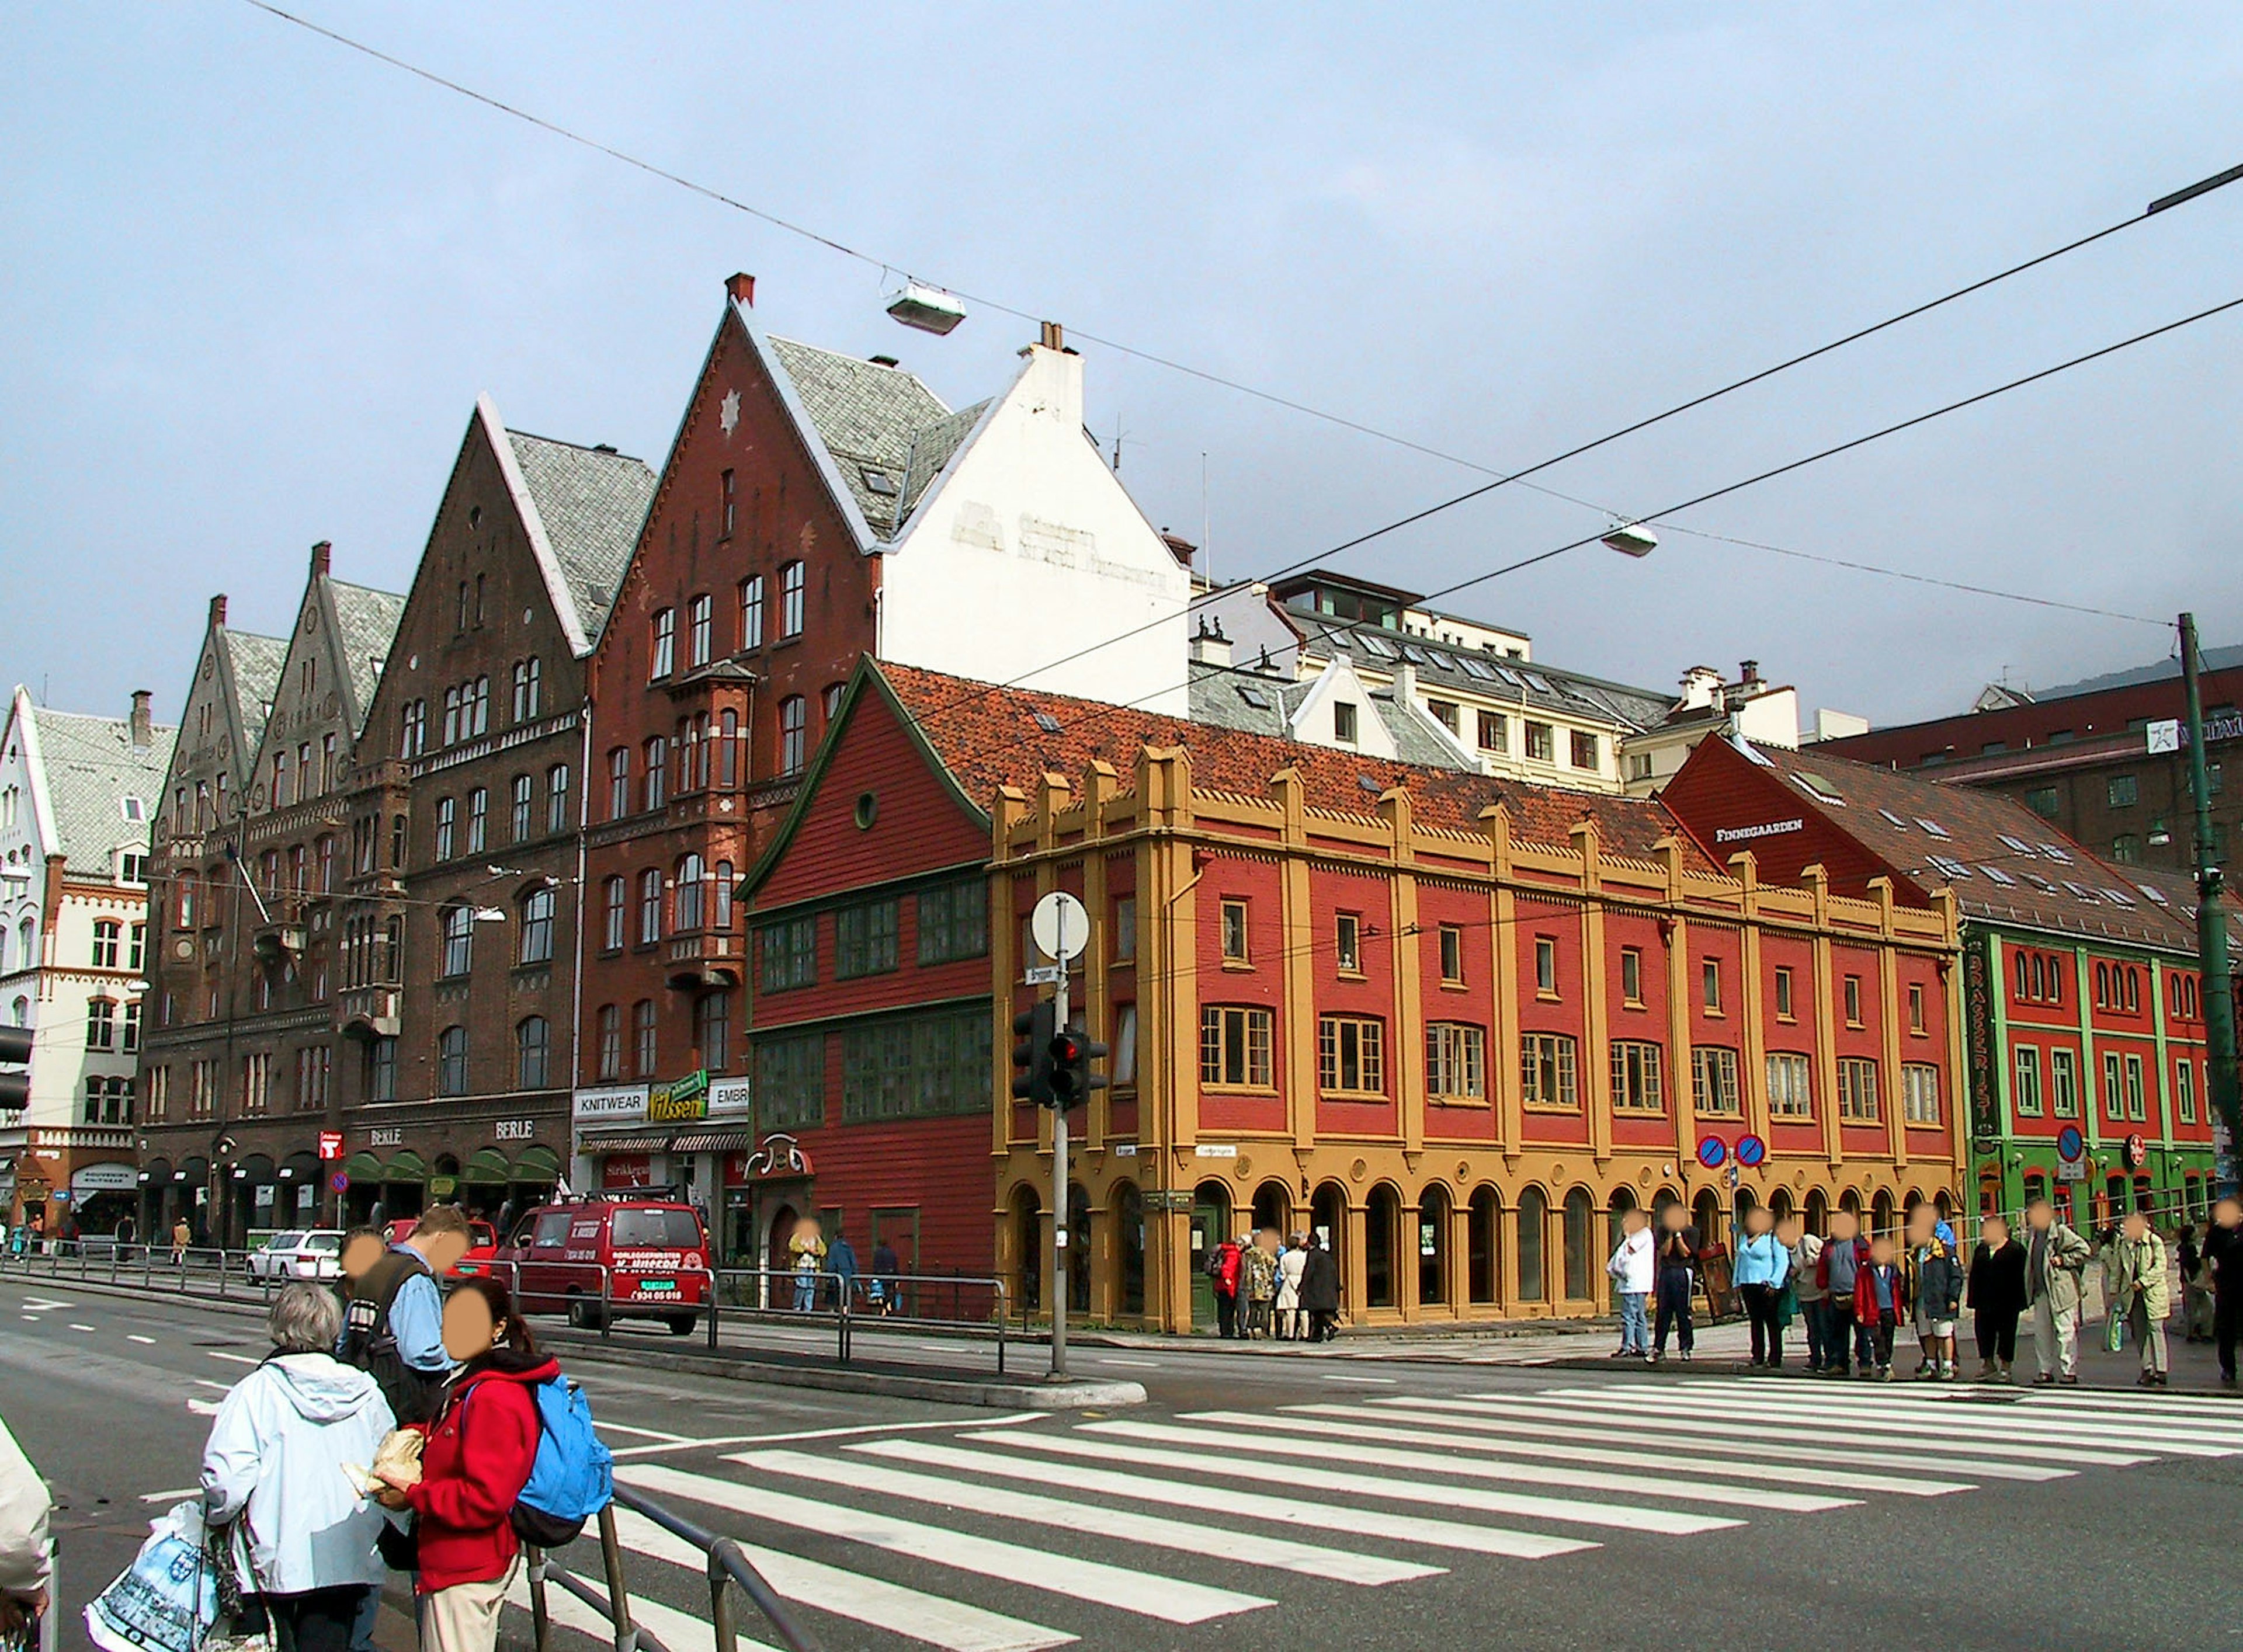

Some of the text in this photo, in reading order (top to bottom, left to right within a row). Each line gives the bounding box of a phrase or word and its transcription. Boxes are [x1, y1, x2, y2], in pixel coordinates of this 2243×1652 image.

[1716, 819, 1803, 842] FINNEGAARDEN
[581, 1095, 641, 1111] KNITWEAR
[370, 1128, 402, 1146] BERLE
[495, 1120, 534, 1140] BERLE
